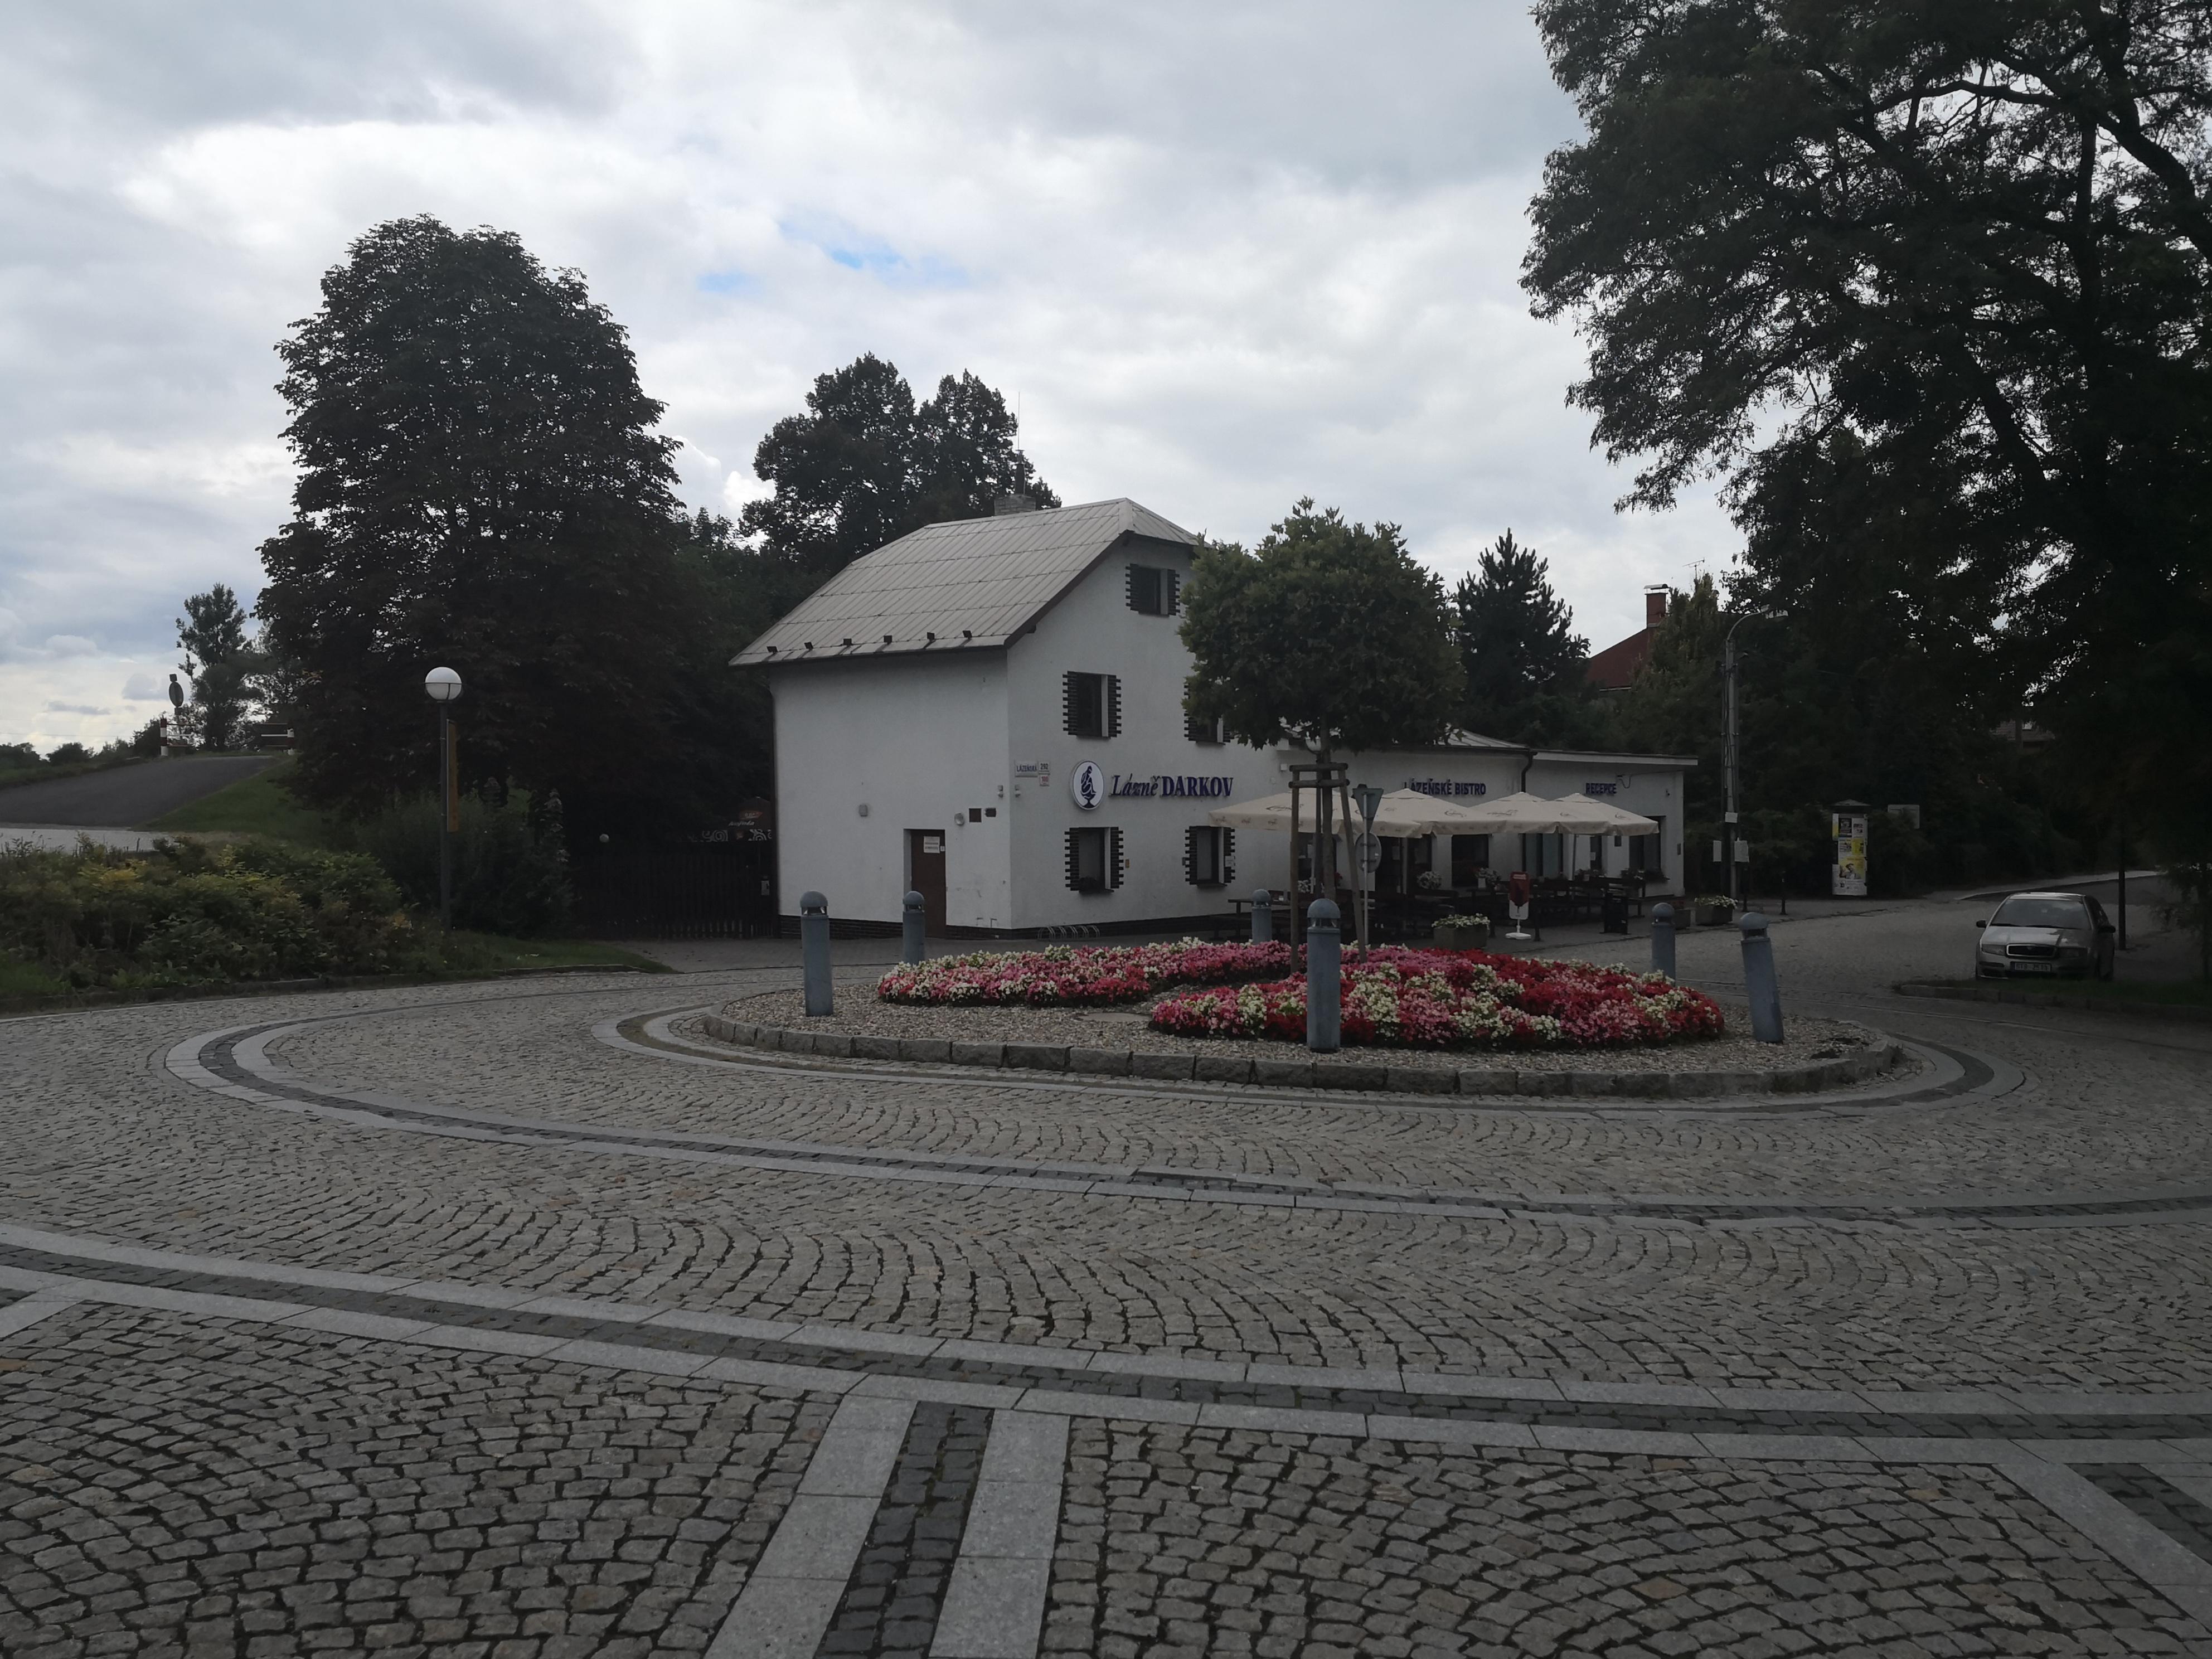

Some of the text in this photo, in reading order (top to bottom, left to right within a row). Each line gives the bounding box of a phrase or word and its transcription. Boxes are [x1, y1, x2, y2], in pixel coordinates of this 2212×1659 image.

[1110, 773, 1234, 797] Lázně DARKOV
[1454, 783, 1486, 795] BISTRO
[1586, 783, 1617, 794] RECEPCE
